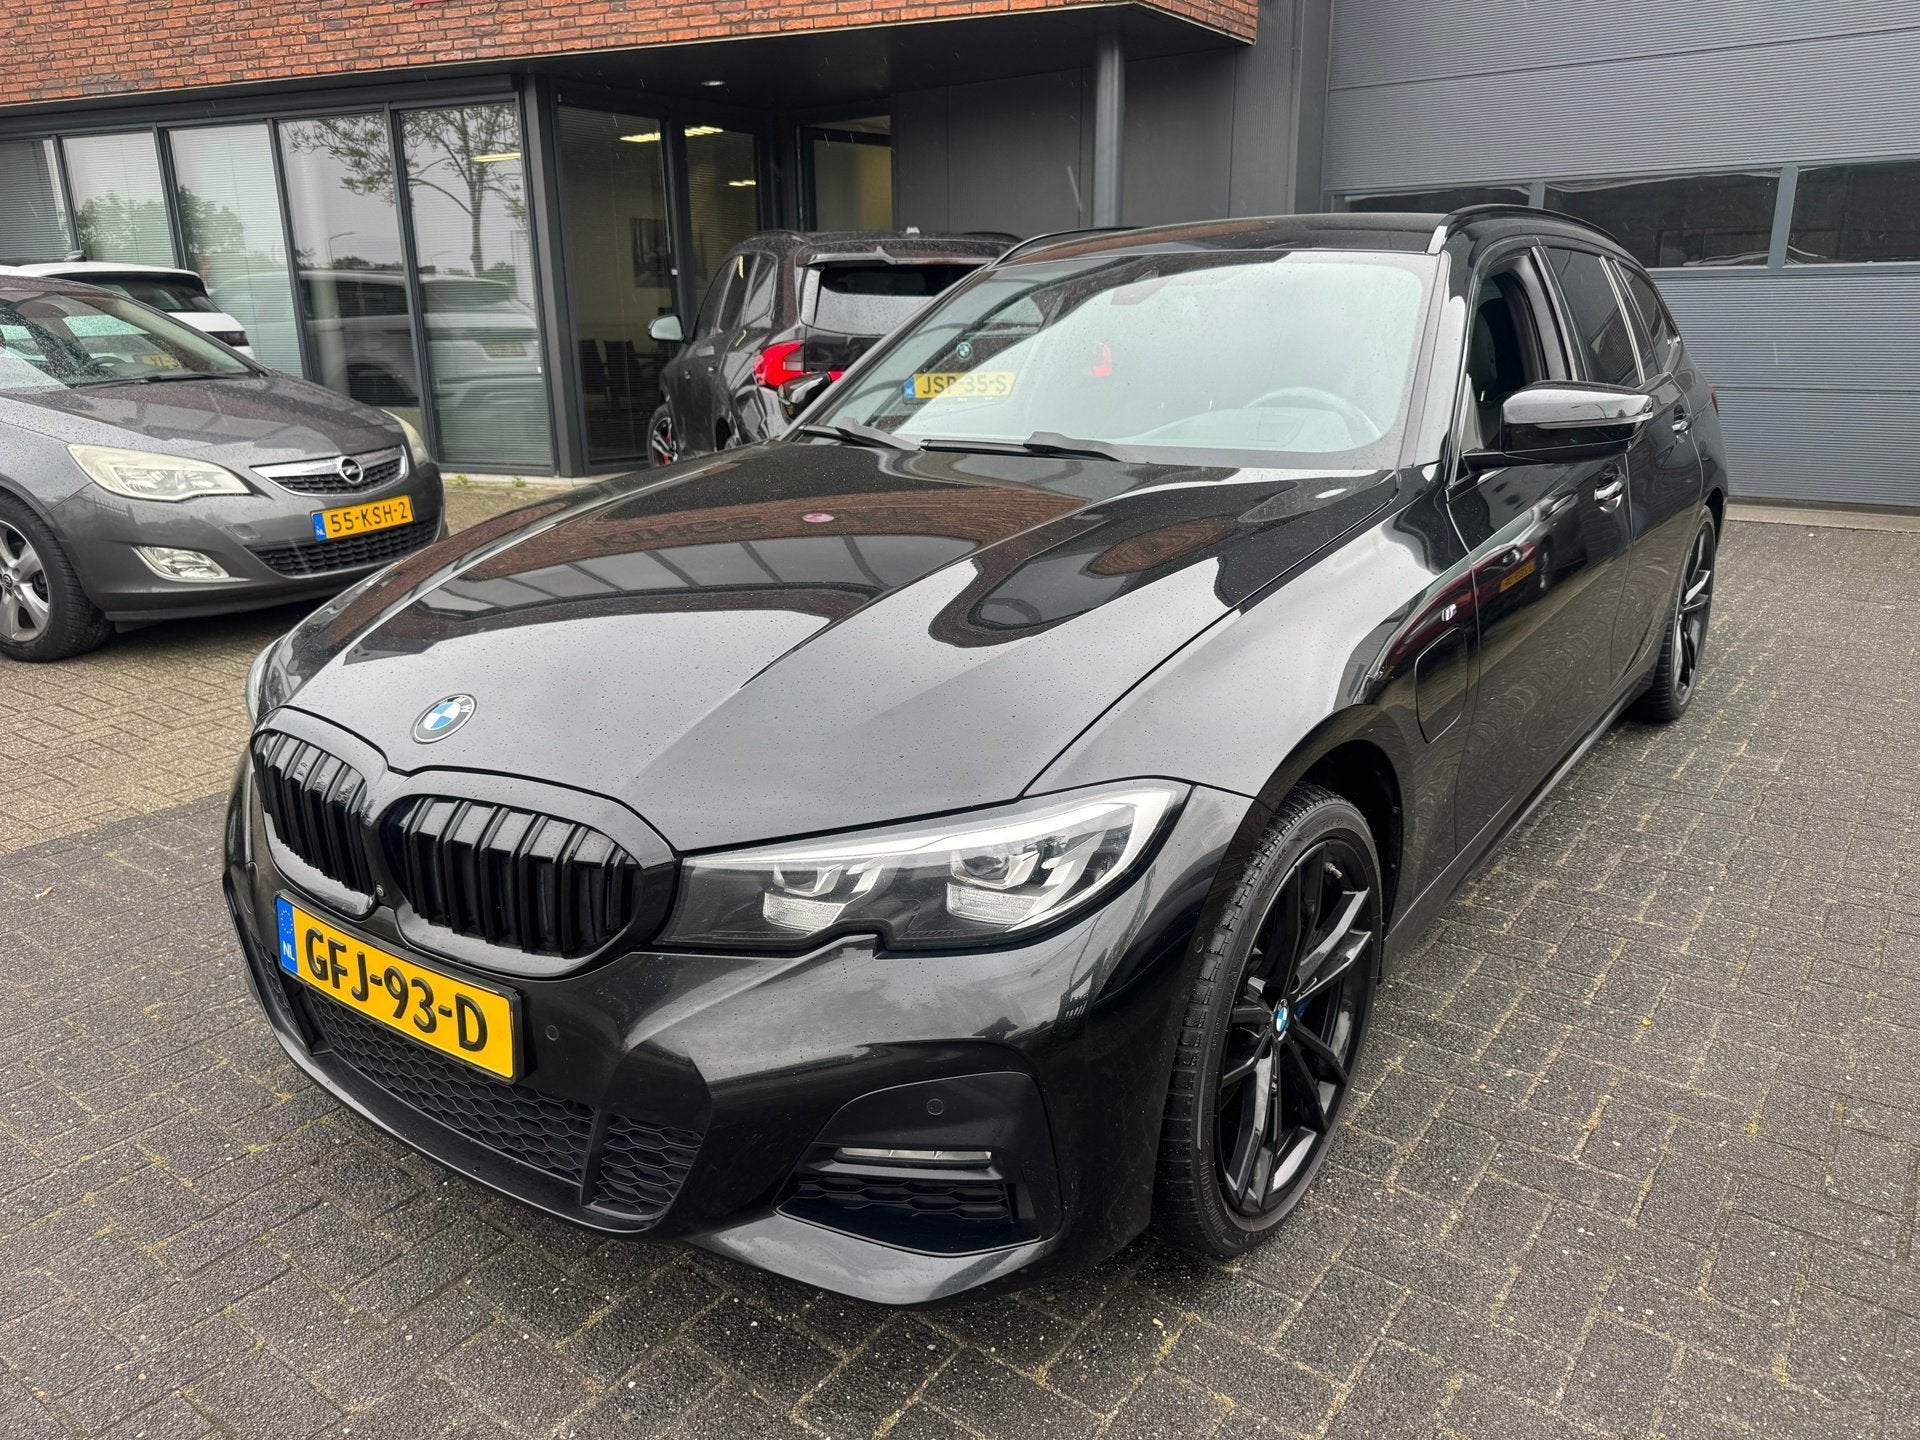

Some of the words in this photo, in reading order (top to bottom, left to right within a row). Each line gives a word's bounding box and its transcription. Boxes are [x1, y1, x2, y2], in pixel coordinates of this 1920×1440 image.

[330, 501, 408, 532] 55-KSH-2
[282, 940, 296, 961] NL
[305, 927, 488, 1052] GFJ-93-D
[1199, 1155, 1227, 1237] BRIDGESTONE
